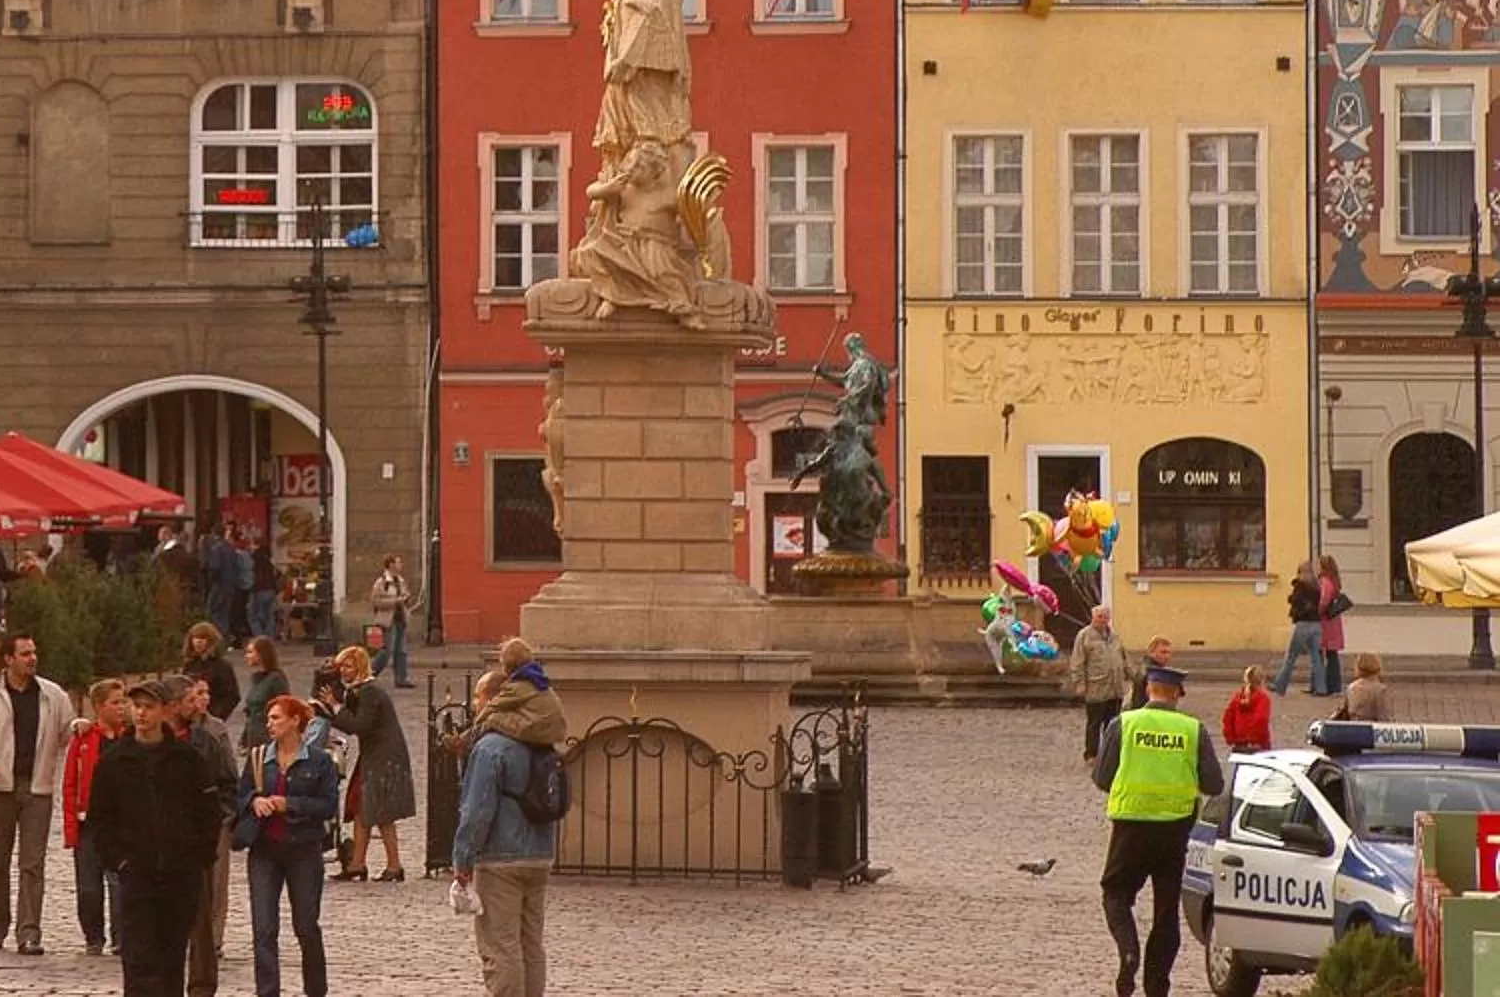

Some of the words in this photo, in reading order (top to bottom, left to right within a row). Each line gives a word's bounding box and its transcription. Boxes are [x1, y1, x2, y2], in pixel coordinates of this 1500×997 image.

[945, 305, 1031, 332] Gino
[1135, 732, 1185, 750] POLICJA
[1374, 727, 1423, 744] POLICJA
[1233, 870, 1327, 911] POLICJA
